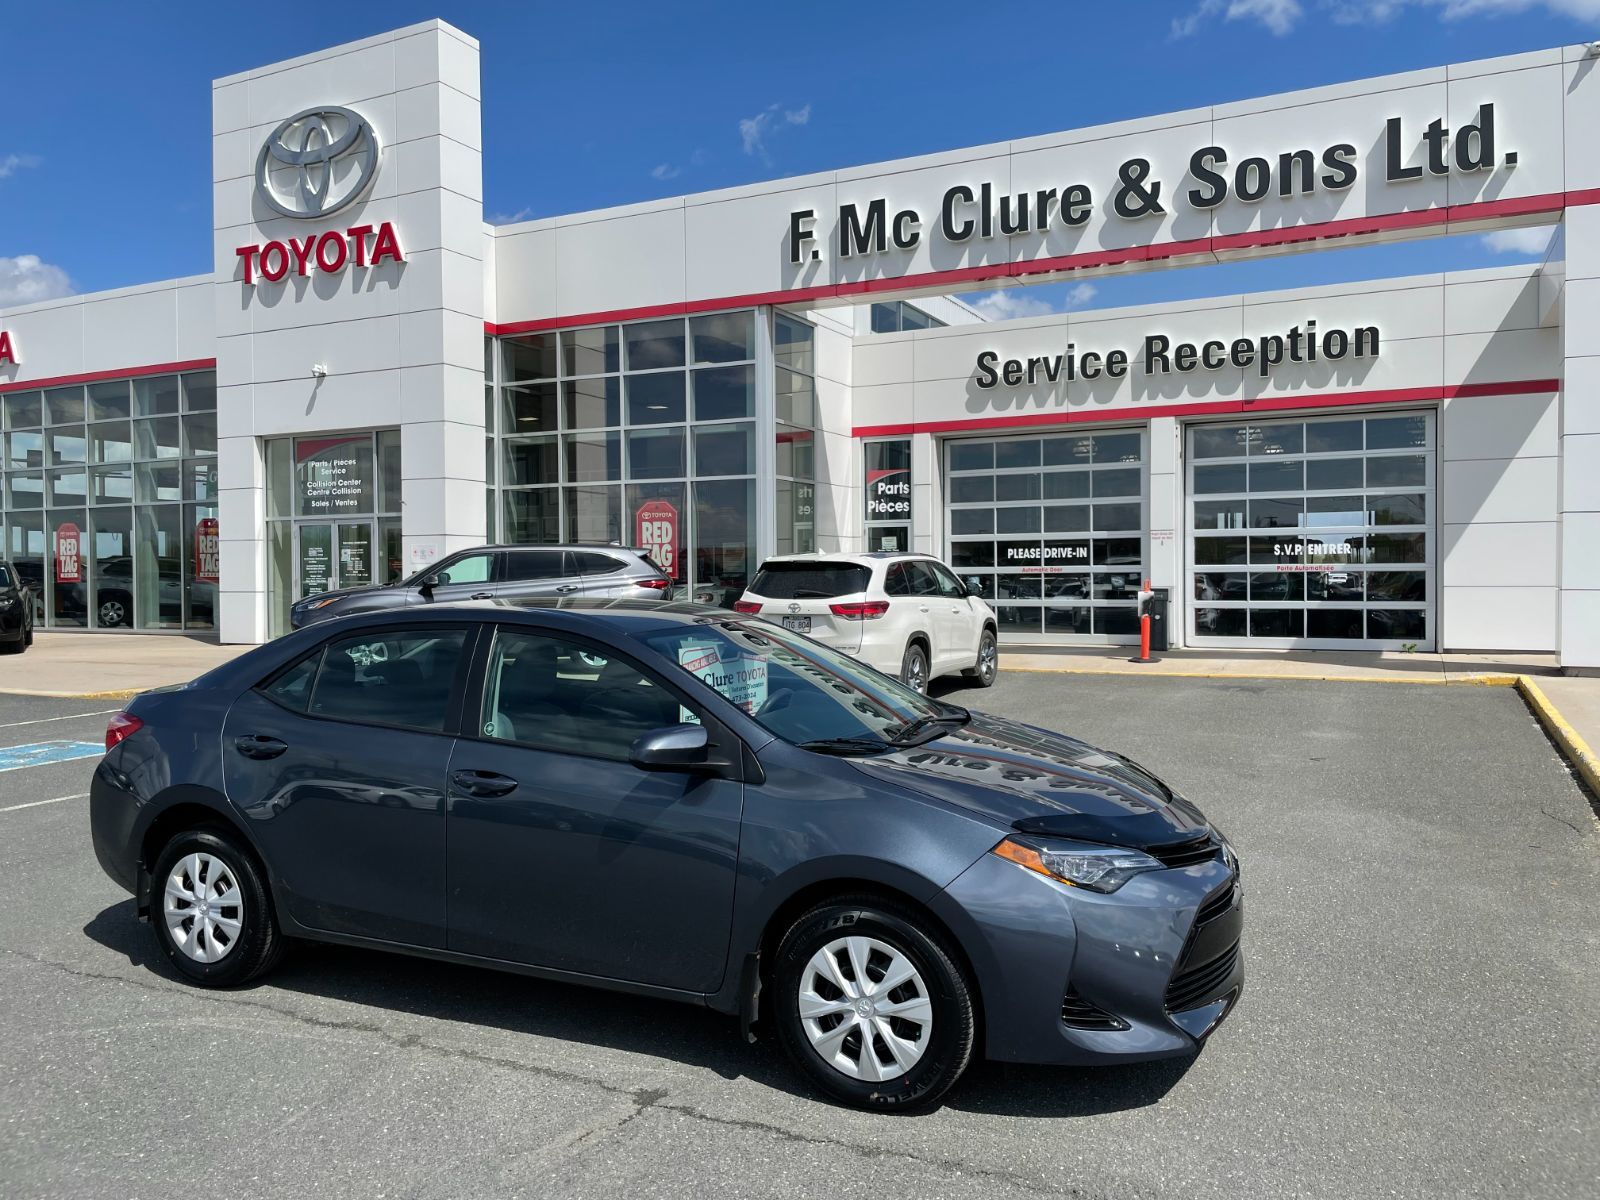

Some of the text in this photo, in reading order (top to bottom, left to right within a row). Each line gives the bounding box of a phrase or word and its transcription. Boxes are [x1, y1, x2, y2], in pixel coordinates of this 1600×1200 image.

[790, 102, 1518, 263] F. Mc Clure & Sons Ltd.
[236, 221, 406, 285] TOYOTA
[975, 319, 1380, 390] Service Reception
[307, 479, 362, 488] Collision Center
[307, 487, 362, 496] Centre Collision
[877, 482, 910, 495] Parts
[867, 498, 910, 513] Pièces
[641, 521, 673, 544] RED
[60, 538, 78, 556] RED
[1007, 547, 1088, 559] PLEASE DRIVE-IN
[1273, 542, 1351, 556] S.V.P. ENTRER
[60, 555, 78, 573] TAG
[200, 553, 219, 573] TAG
[704, 667, 766, 687] Clure TOYOTA
